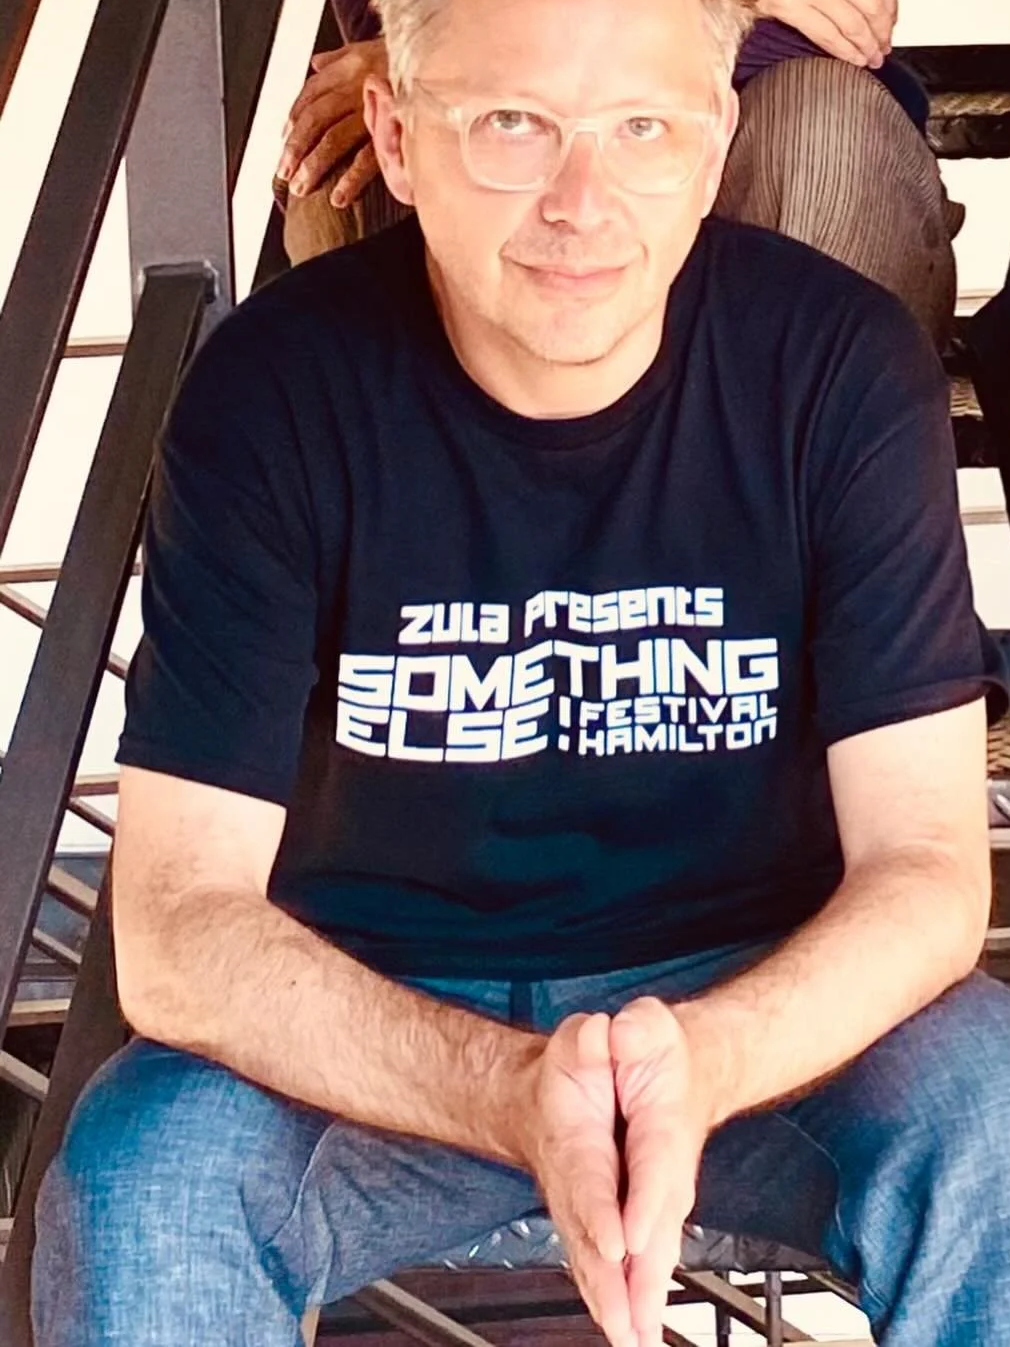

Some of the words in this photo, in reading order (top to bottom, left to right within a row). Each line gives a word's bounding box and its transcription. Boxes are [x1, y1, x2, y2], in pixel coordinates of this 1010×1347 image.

[337, 638, 779, 712] SOMETHING
[579, 694, 778, 728] FESTIVAL
[578, 716, 777, 756] HAMILTON
